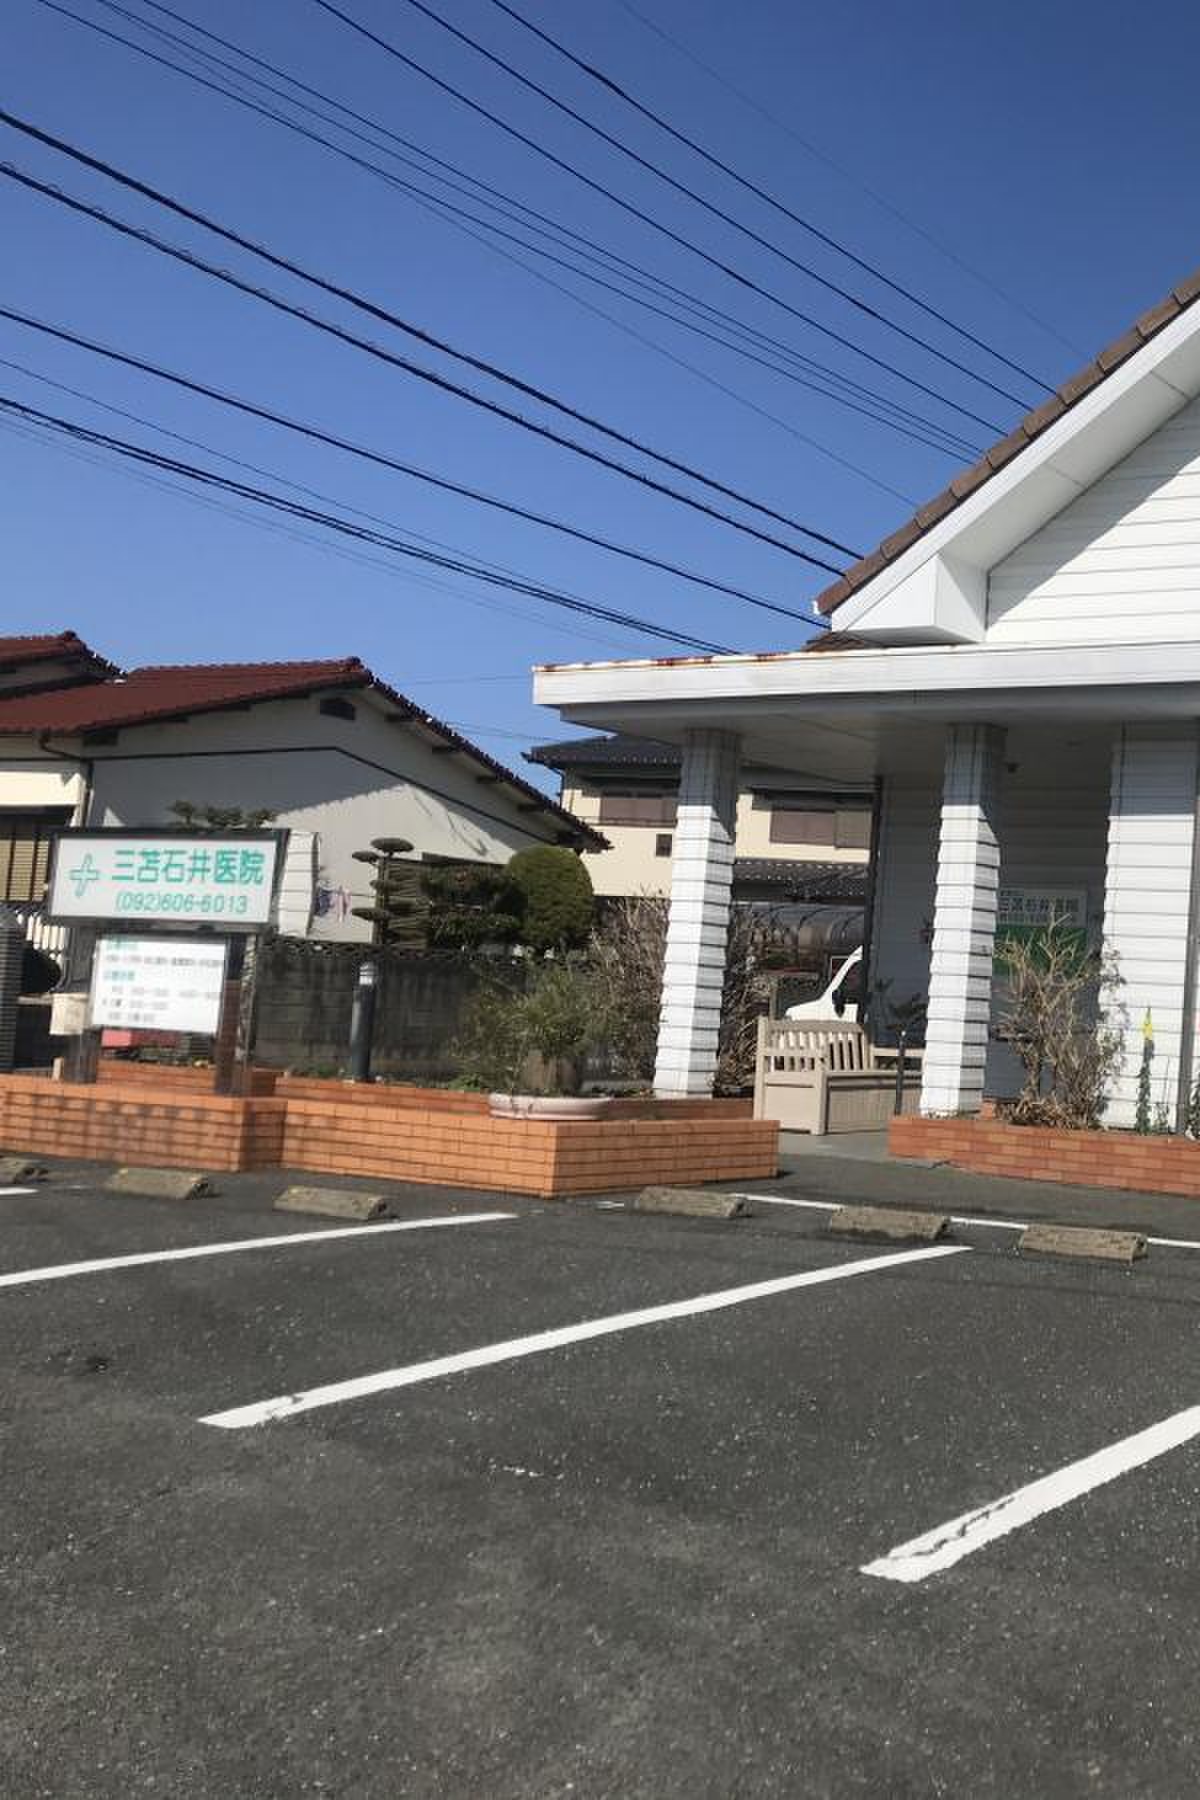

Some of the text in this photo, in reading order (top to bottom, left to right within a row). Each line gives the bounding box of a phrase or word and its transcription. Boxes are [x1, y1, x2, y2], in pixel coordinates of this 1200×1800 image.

[112, 848, 265, 884] 三苫石井医院
